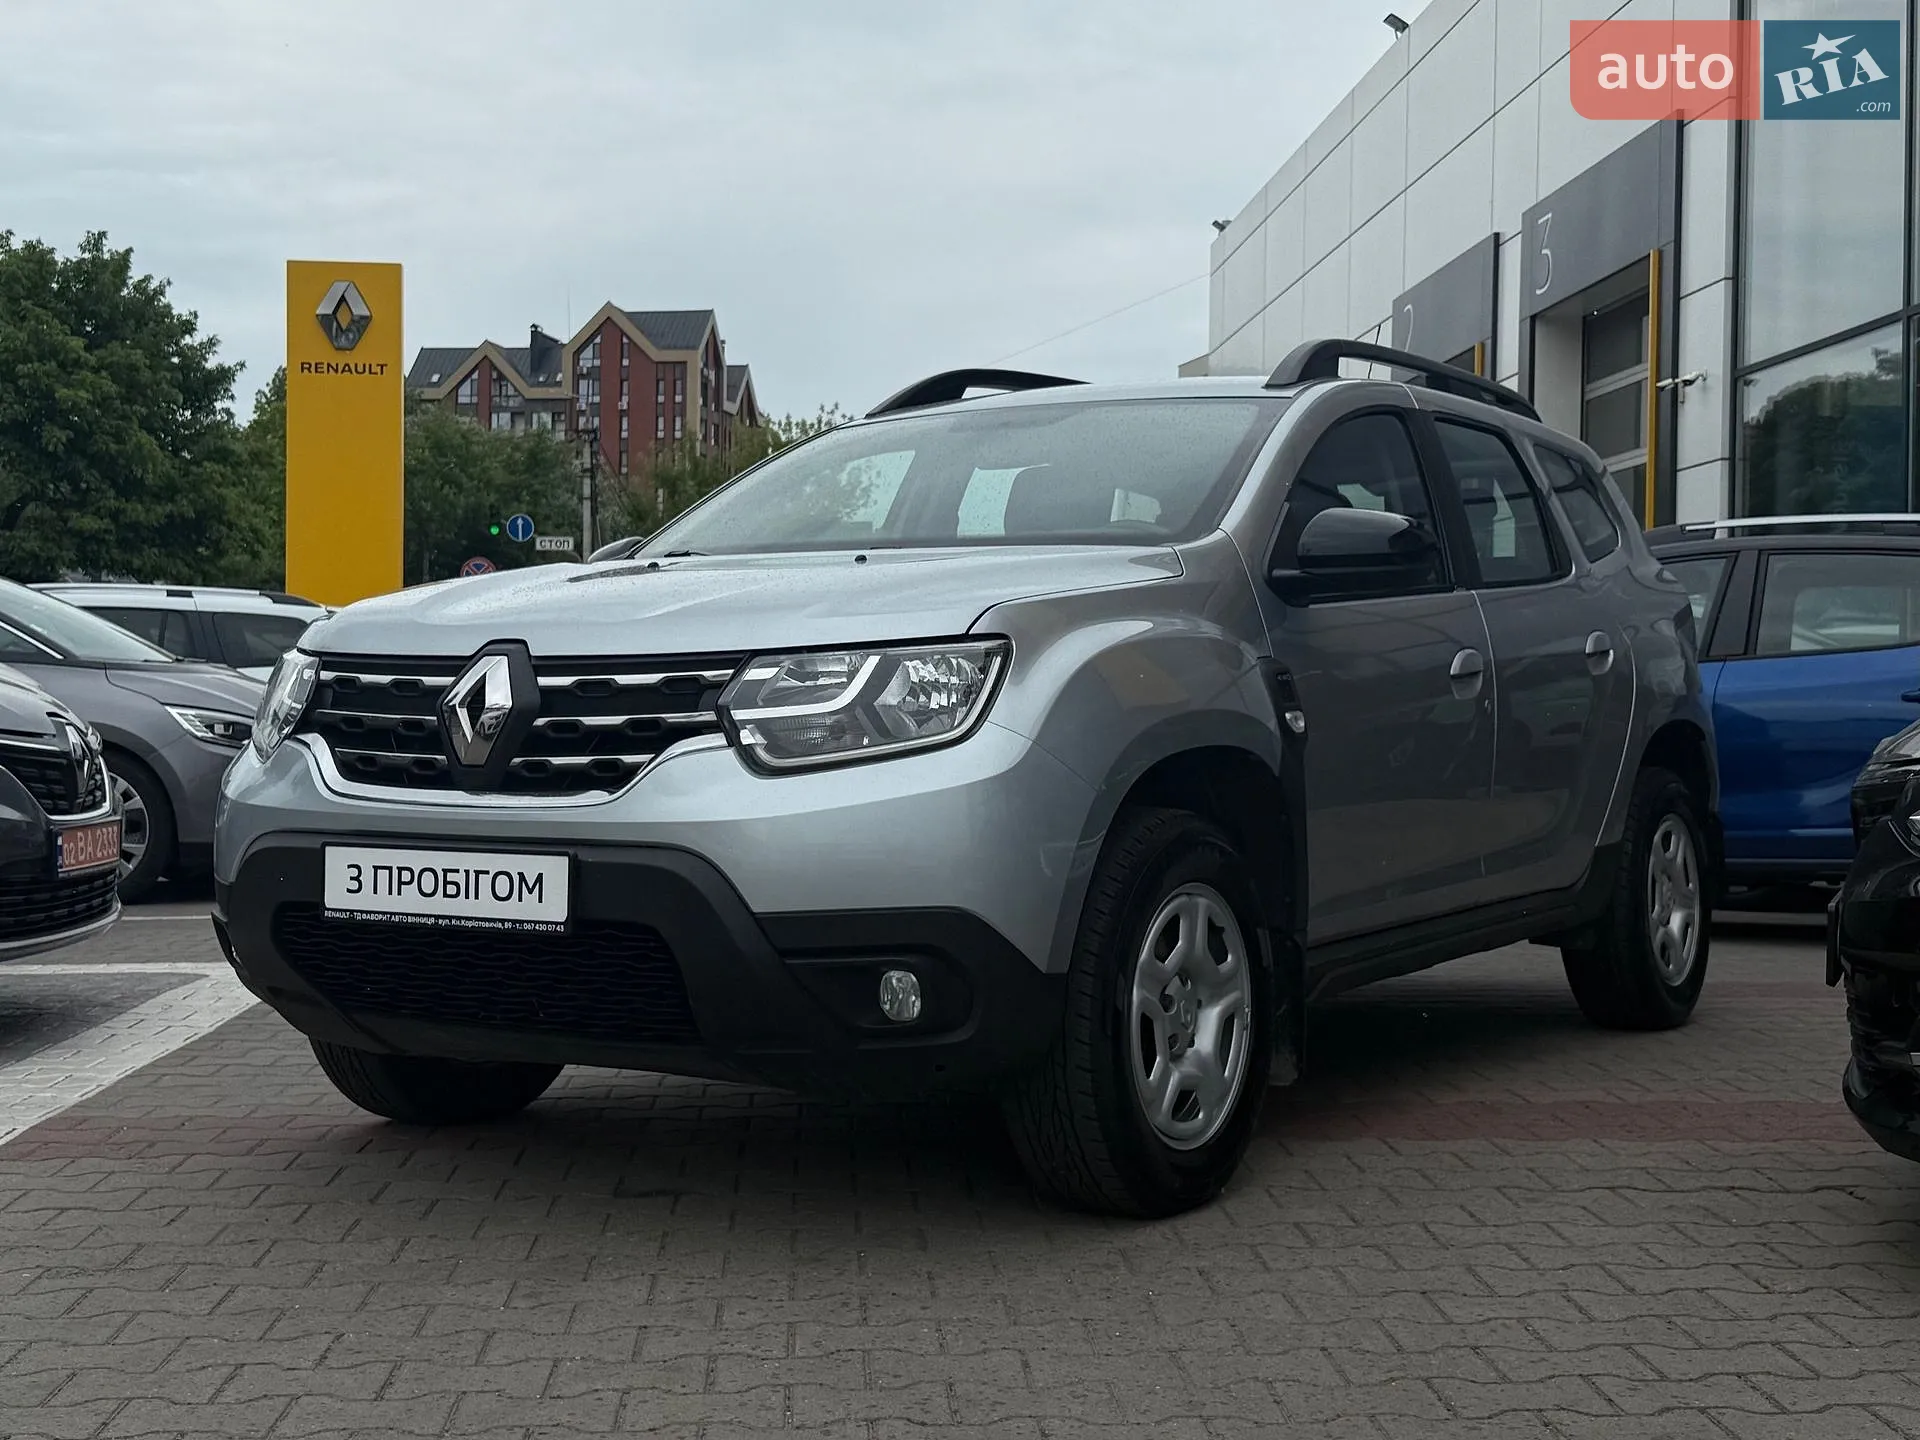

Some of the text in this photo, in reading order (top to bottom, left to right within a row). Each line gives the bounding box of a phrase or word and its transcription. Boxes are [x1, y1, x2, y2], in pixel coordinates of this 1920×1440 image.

[1535, 212, 1553, 295] 3
[1403, 303, 1413, 353] 2
[300, 361, 388, 376] RENAULT
[539, 539, 570, 549] СТОП
[64, 826, 118, 865] 02 BA 2333
[345, 863, 544, 904] З ПРОБІГОМ
[324, 910, 350, 918] RENAULT
[353, 912, 362, 921] ТД
[362, 913, 391, 922] ФАВОРИТ
[391, 914, 407, 922] АВТО
[407, 916, 435, 925] ВІННИЦЯ
[523, 922, 535, 930] 067
